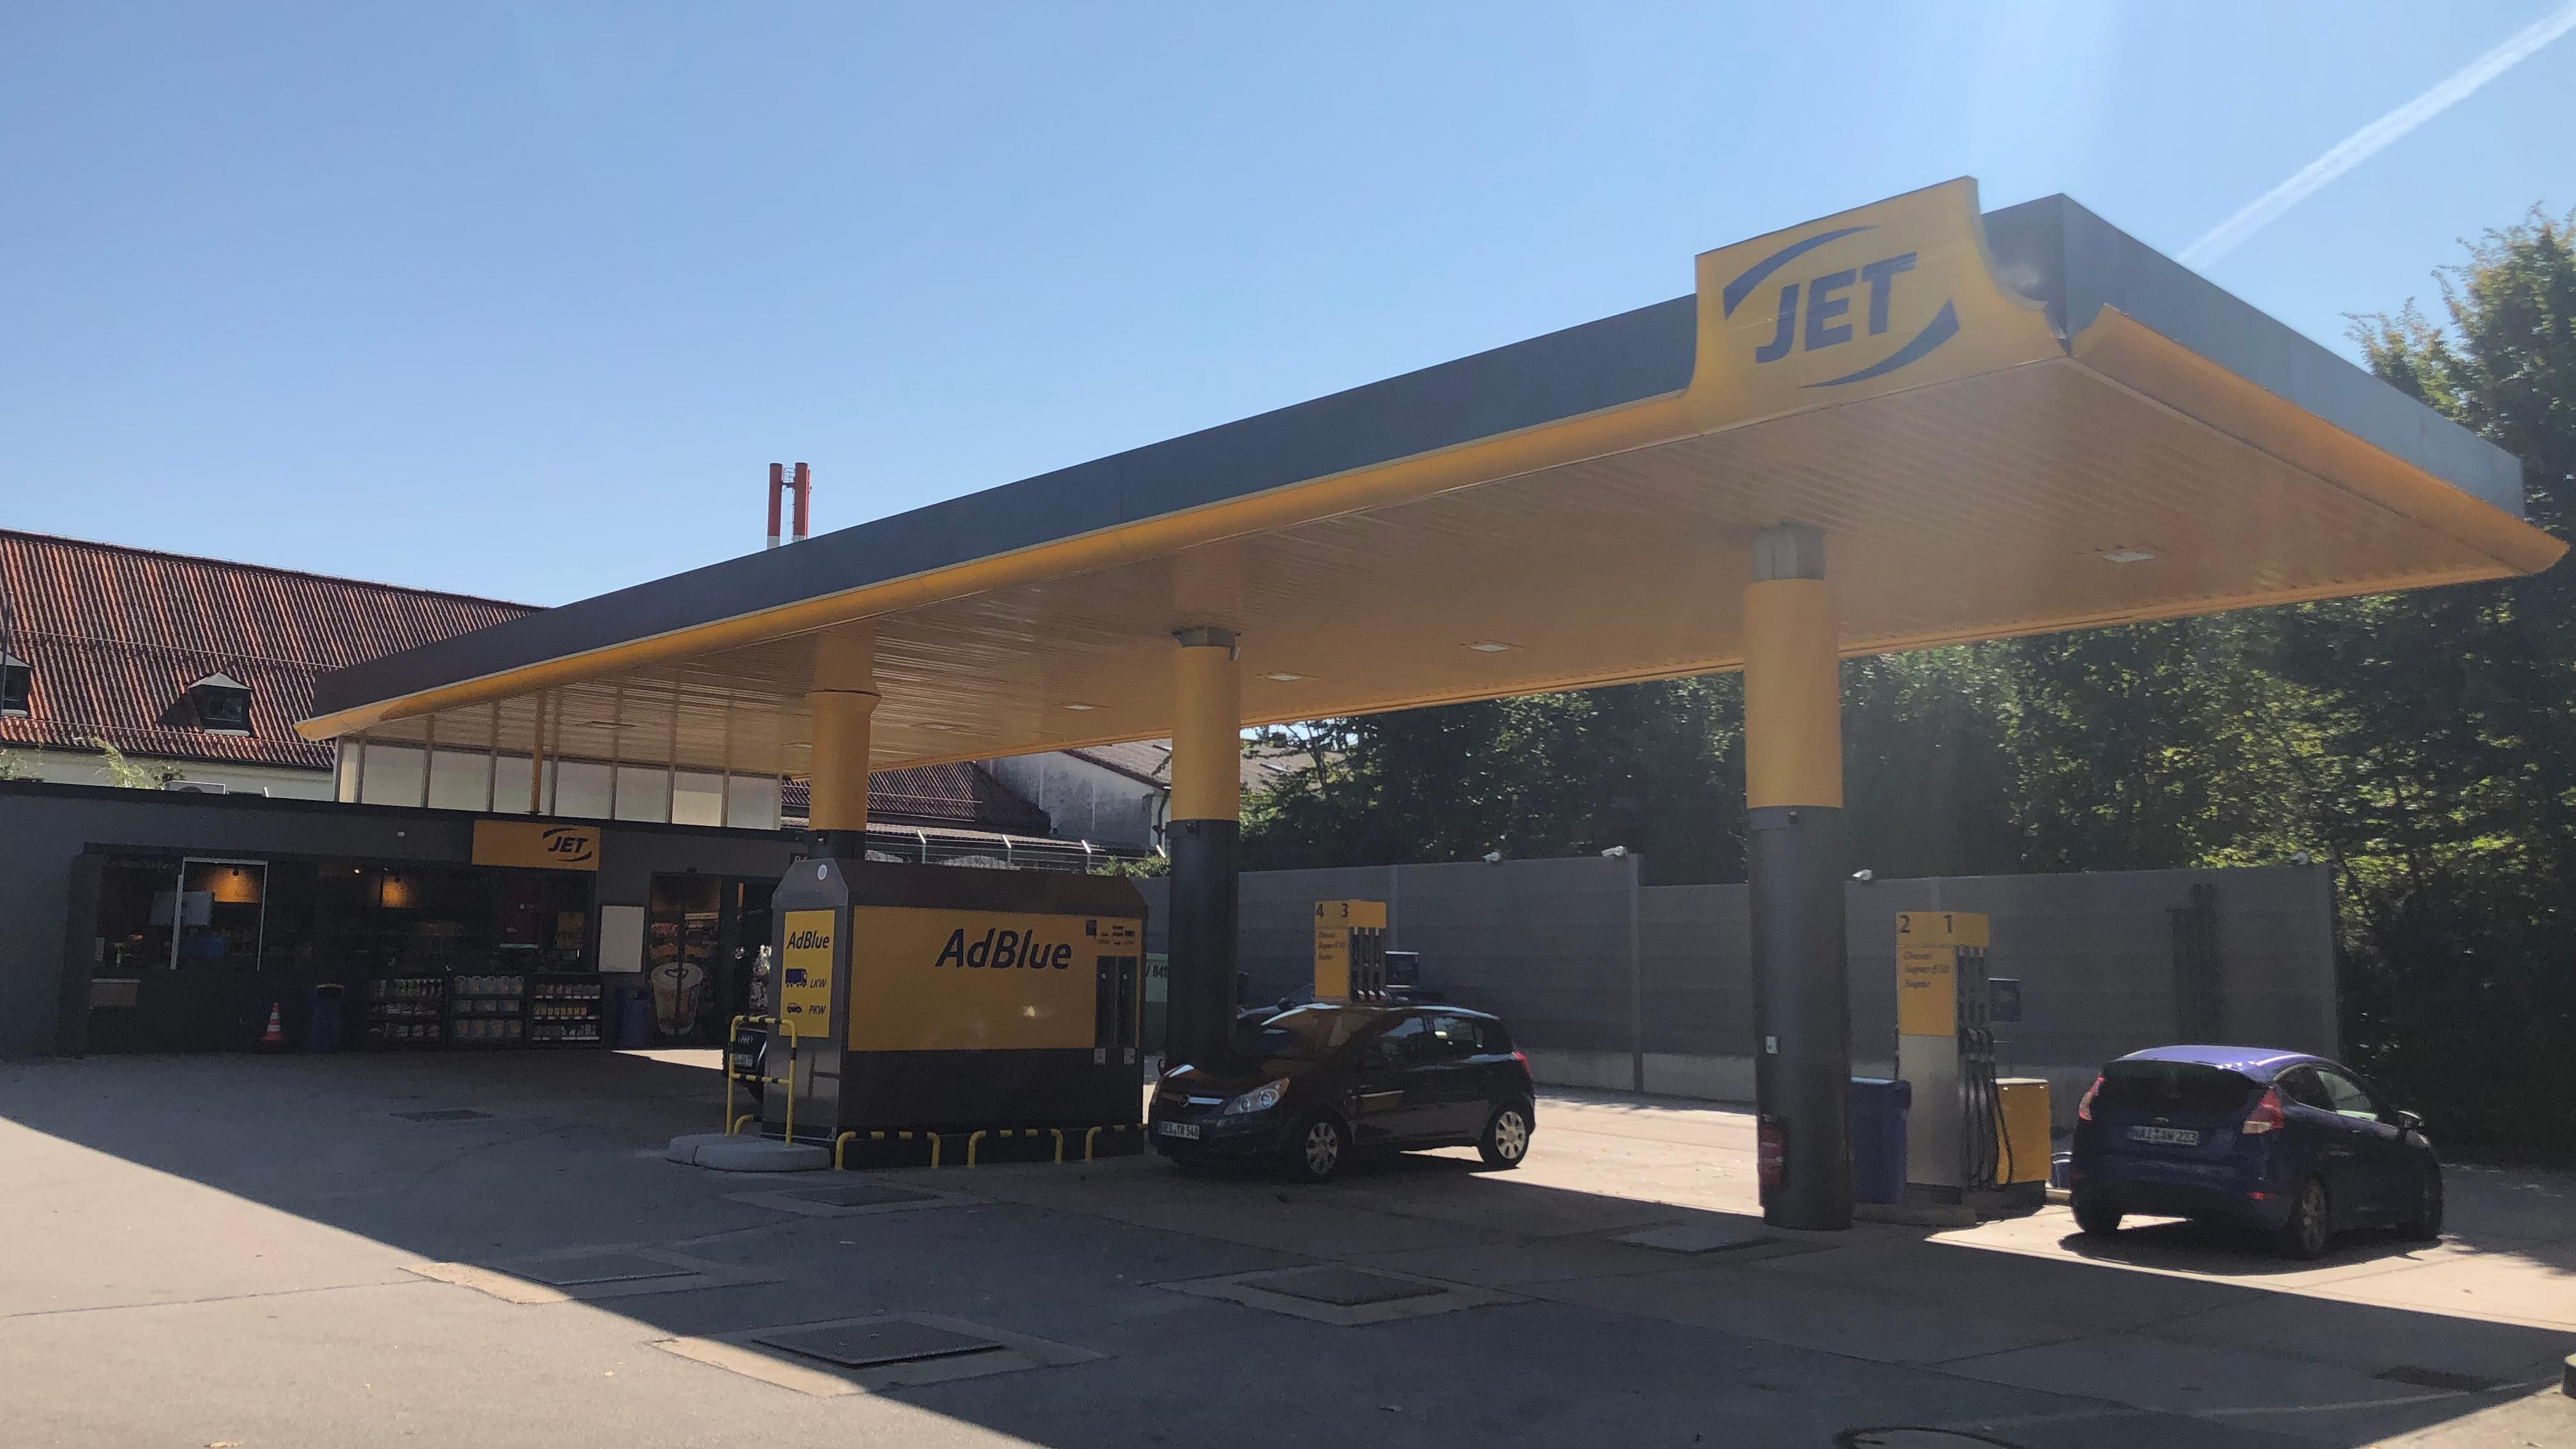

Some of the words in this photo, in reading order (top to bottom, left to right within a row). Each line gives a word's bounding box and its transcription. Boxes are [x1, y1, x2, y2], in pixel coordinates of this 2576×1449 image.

[1755, 251, 1917, 364] JET
[547, 836, 588, 854] JET
[1317, 904, 1324, 917] 4
[1341, 903, 1348, 917] 3
[1900, 914, 1910, 933] 2
[1943, 914, 1952, 933] 1
[786, 930, 830, 949] AdBlue
[934, 927, 1073, 970] AdBlue
[809, 978, 827, 988] LKW
[808, 1004, 827, 1015] PKW
